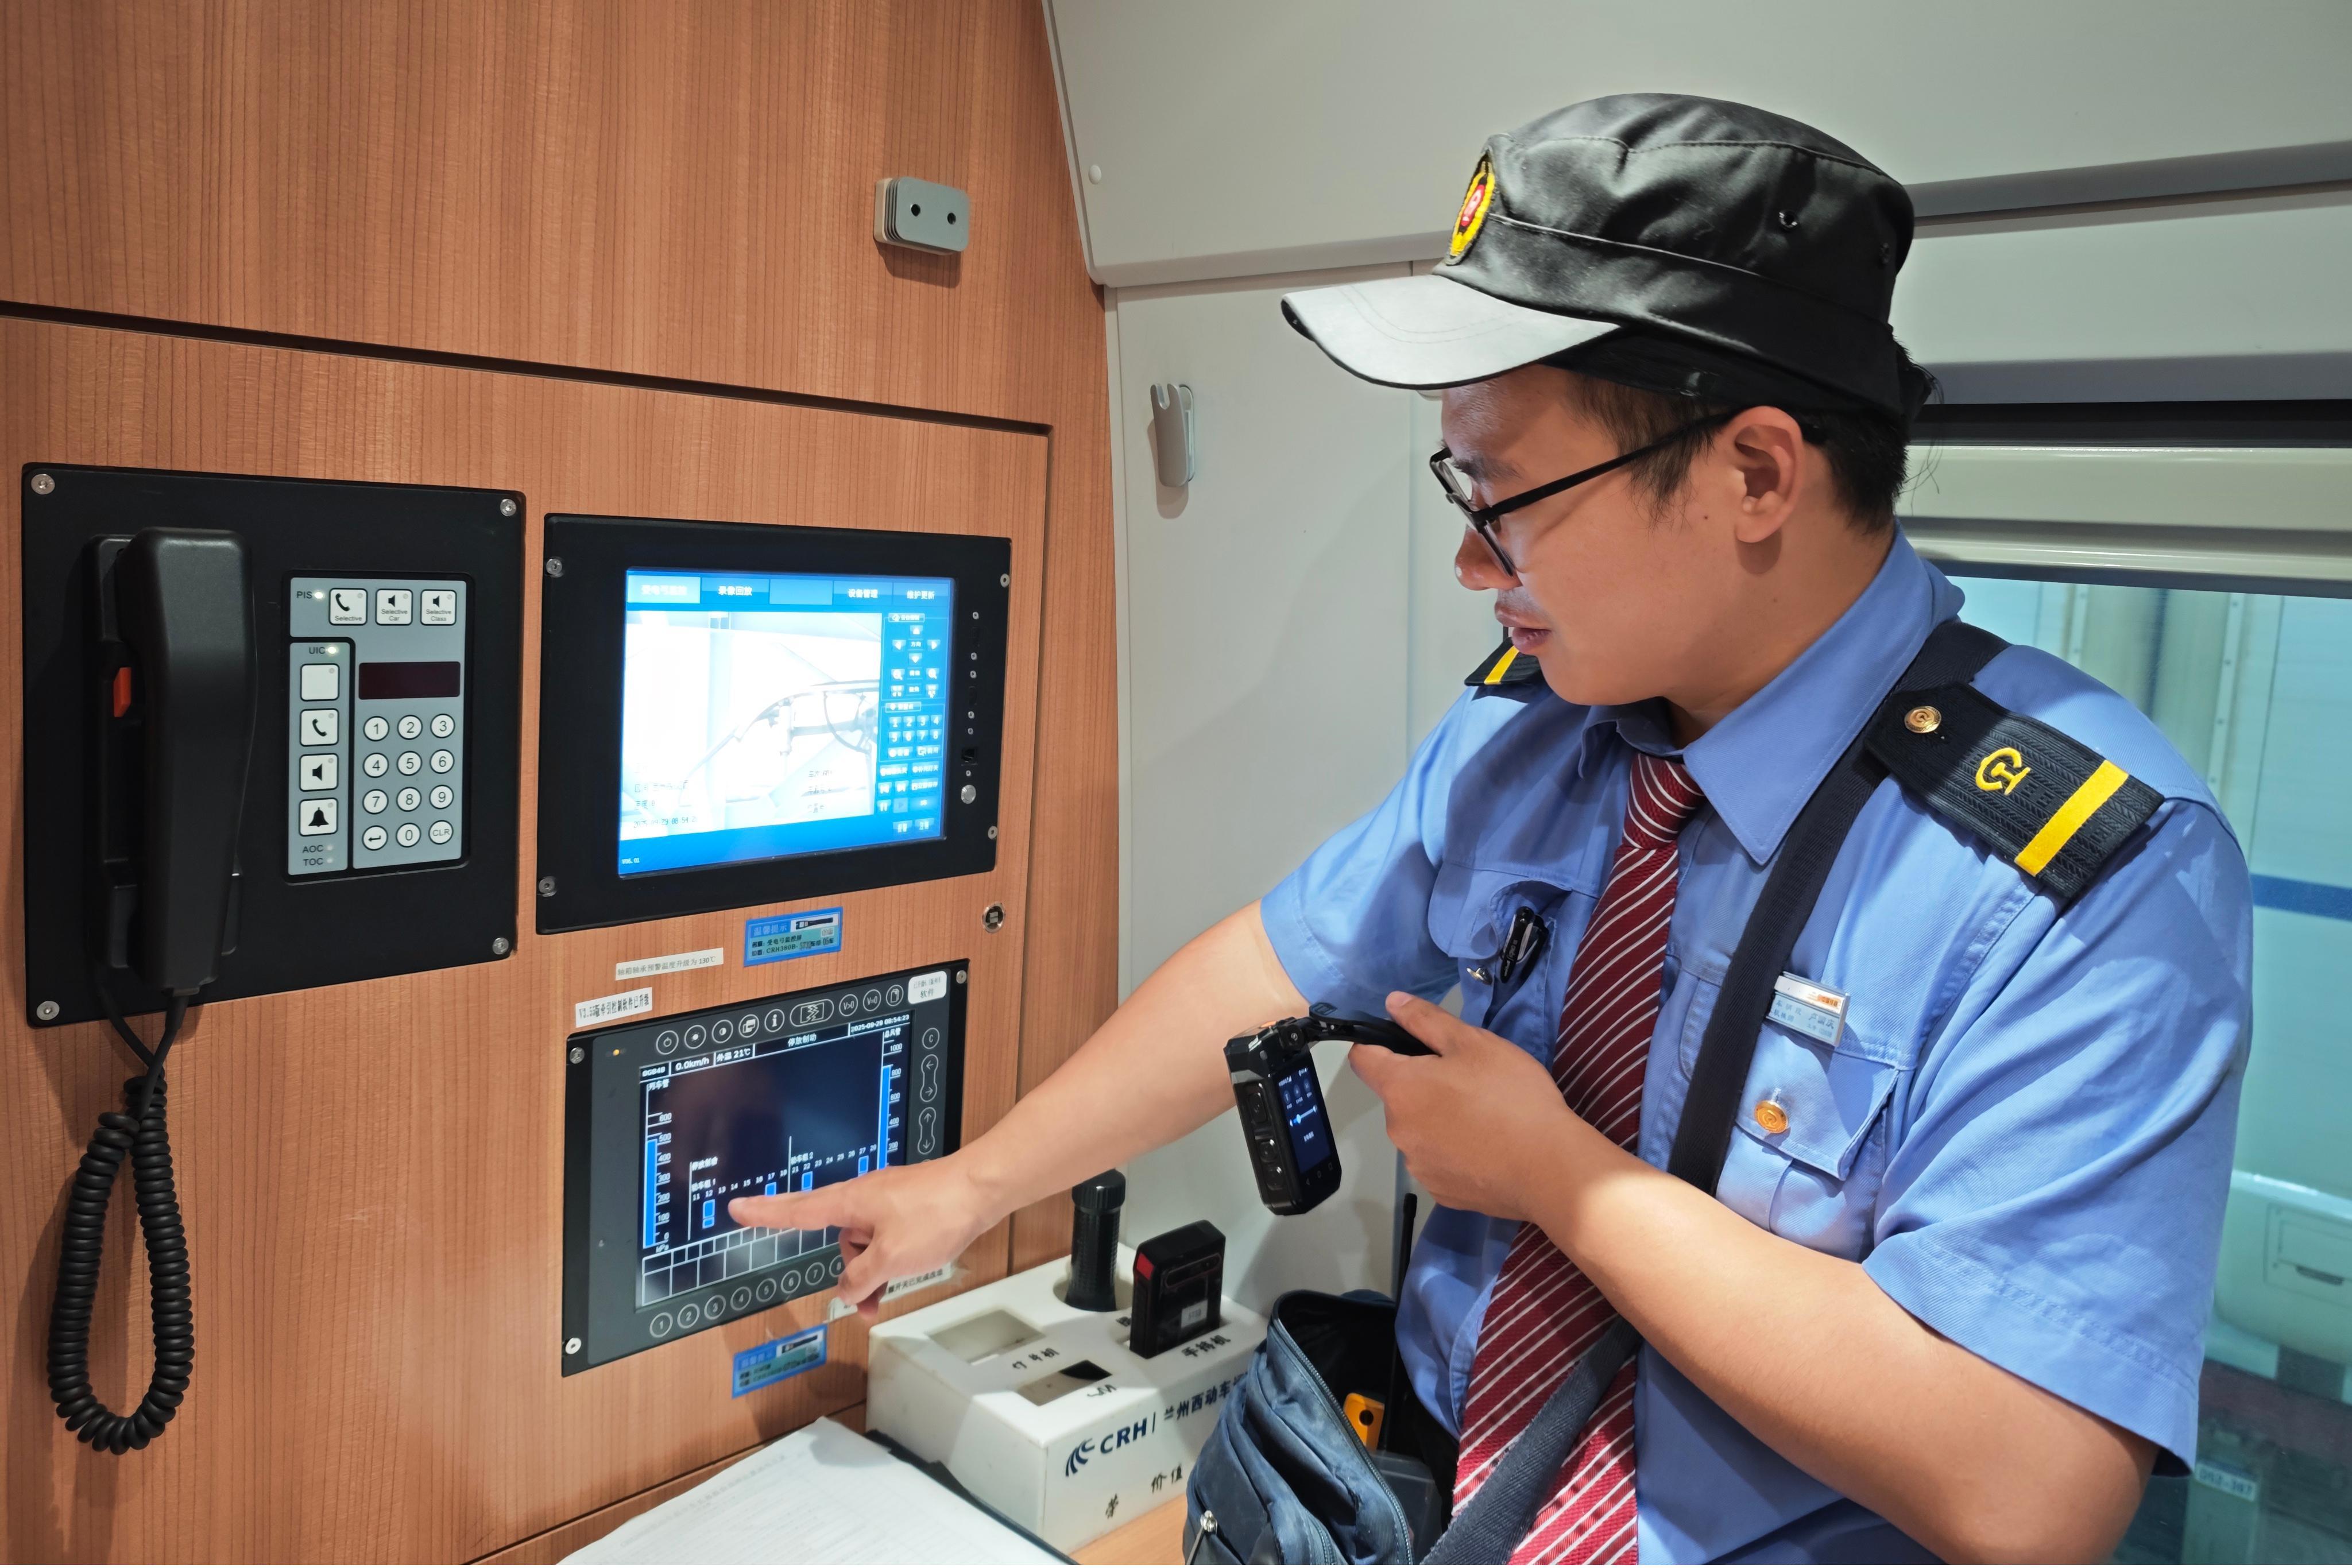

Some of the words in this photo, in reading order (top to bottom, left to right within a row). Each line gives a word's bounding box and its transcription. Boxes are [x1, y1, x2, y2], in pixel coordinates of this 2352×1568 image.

[296, 591, 312, 599] PIS
[718, 585, 753, 596] 录像回放
[848, 589, 878, 598] 设备管理
[907, 590, 935, 599] 维护更新
[308, 646, 326, 655] UIC
[893, 718, 898, 727] 1
[906, 717, 912, 726] 2
[920, 717, 926, 726] 3
[934, 716, 939, 725] 4
[373, 723, 380, 734] 1
[407, 722, 415, 733] 2
[439, 721, 447, 731] 3
[892, 733, 898, 742] 5
[906, 732, 912, 741] 6
[920, 731, 926, 740] 7
[933, 730, 938, 739] 8
[372, 760, 380, 771] 4
[407, 758, 414, 769] 5
[439, 756, 446, 767] 6
[372, 796, 380, 807] 7
[406, 794, 413, 805] 8
[438, 792, 446, 803] 9
[405, 830, 413, 841] 0
[432, 828, 450, 837] CLR
[302, 845, 323, 853] AOC
[303, 858, 323, 866] TOC
[753, 923, 787, 936] 温馨提示
[844, 1000, 854, 1010] V>0
[867, 995, 877, 1005] V=0
[851, 1020, 883, 1032] 2025-09-29
[884, 1015, 910, 1025] 08:54:23
[788, 1033, 817, 1047] 停放制动
[929, 1034, 933, 1043] C
[890, 1043, 903, 1051] 1000
[675, 1057, 709, 1071] 0.0km/h
[891, 1068, 902, 1076] 800
[891, 1092, 900, 1100] 600
[889, 1117, 899, 1125] 400
[659, 1132, 671, 1142] 500
[888, 1141, 898, 1150] 200
[658, 1152, 671, 1162] 400
[792, 1166, 799, 1174] 21
[803, 1163, 810, 1171] 22
[815, 1159, 822, 1168] 23
[826, 1156, 833, 1165] 24
[837, 1153, 844, 1162] 25
[859, 1147, 866, 1155] 27
[657, 1172, 671, 1182] 300
[693, 1193, 700, 1202] 11
[705, 1189, 713, 1198] 12
[718, 1186, 726, 1195] 13
[730, 1183, 738, 1191] 14
[743, 1179, 751, 1187] 15
[756, 1175, 763, 1184] 16
[768, 1172, 775, 1180] 17
[657, 1193, 670, 1202] 200
[657, 1212, 670, 1221] 100
[664, 1232, 670, 1240] 0
[659, 1321, 664, 1330] 1
[686, 1312, 691, 1321] 2
[712, 1302, 718, 1312] 3
[738, 1294, 744, 1303] 4
[764, 1285, 769, 1294] 5
[788, 1277, 794, 1286] 6
[813, 1268, 818, 1277] 7
[1100, 1417, 1147, 1454] CRH
